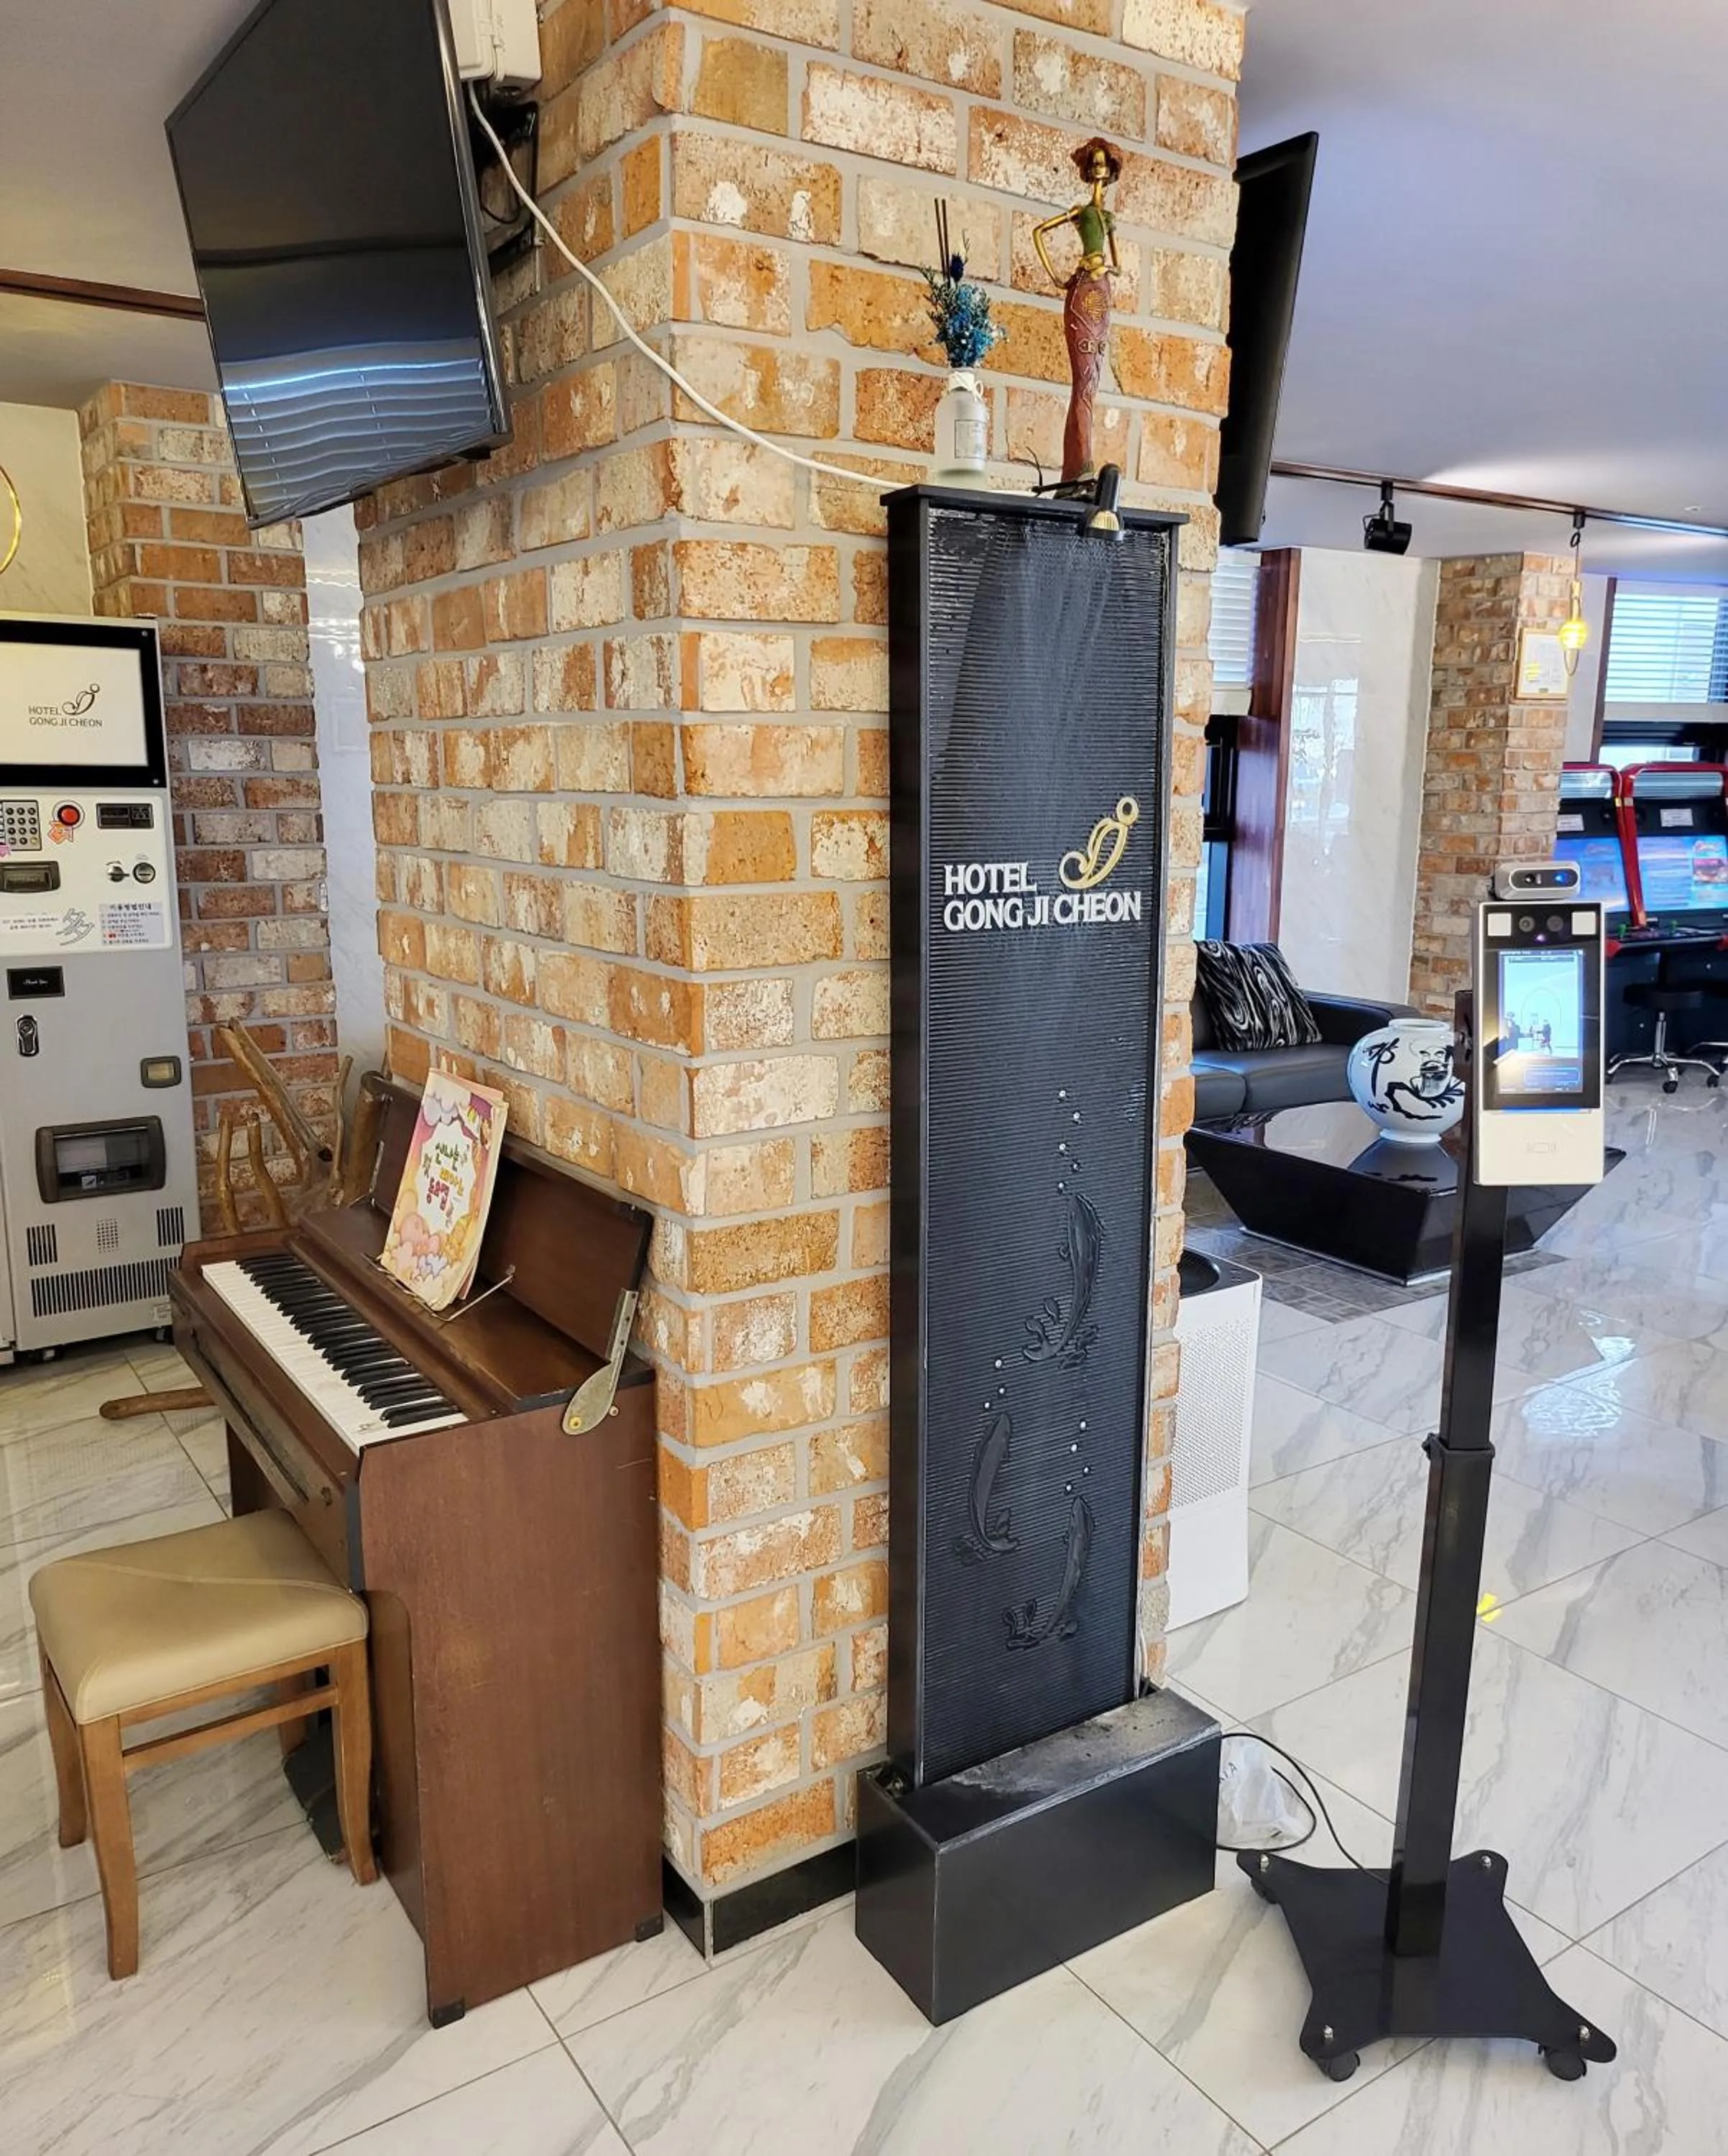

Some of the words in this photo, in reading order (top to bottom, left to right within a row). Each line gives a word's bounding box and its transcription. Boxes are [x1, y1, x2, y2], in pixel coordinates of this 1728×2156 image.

[28, 706, 62, 716] HOTEL
[29, 717, 58, 726] GONG
[944, 862, 1037, 895] HOTEL
[944, 898, 1024, 931] GONG
[1054, 891, 1141, 924] CHEON
